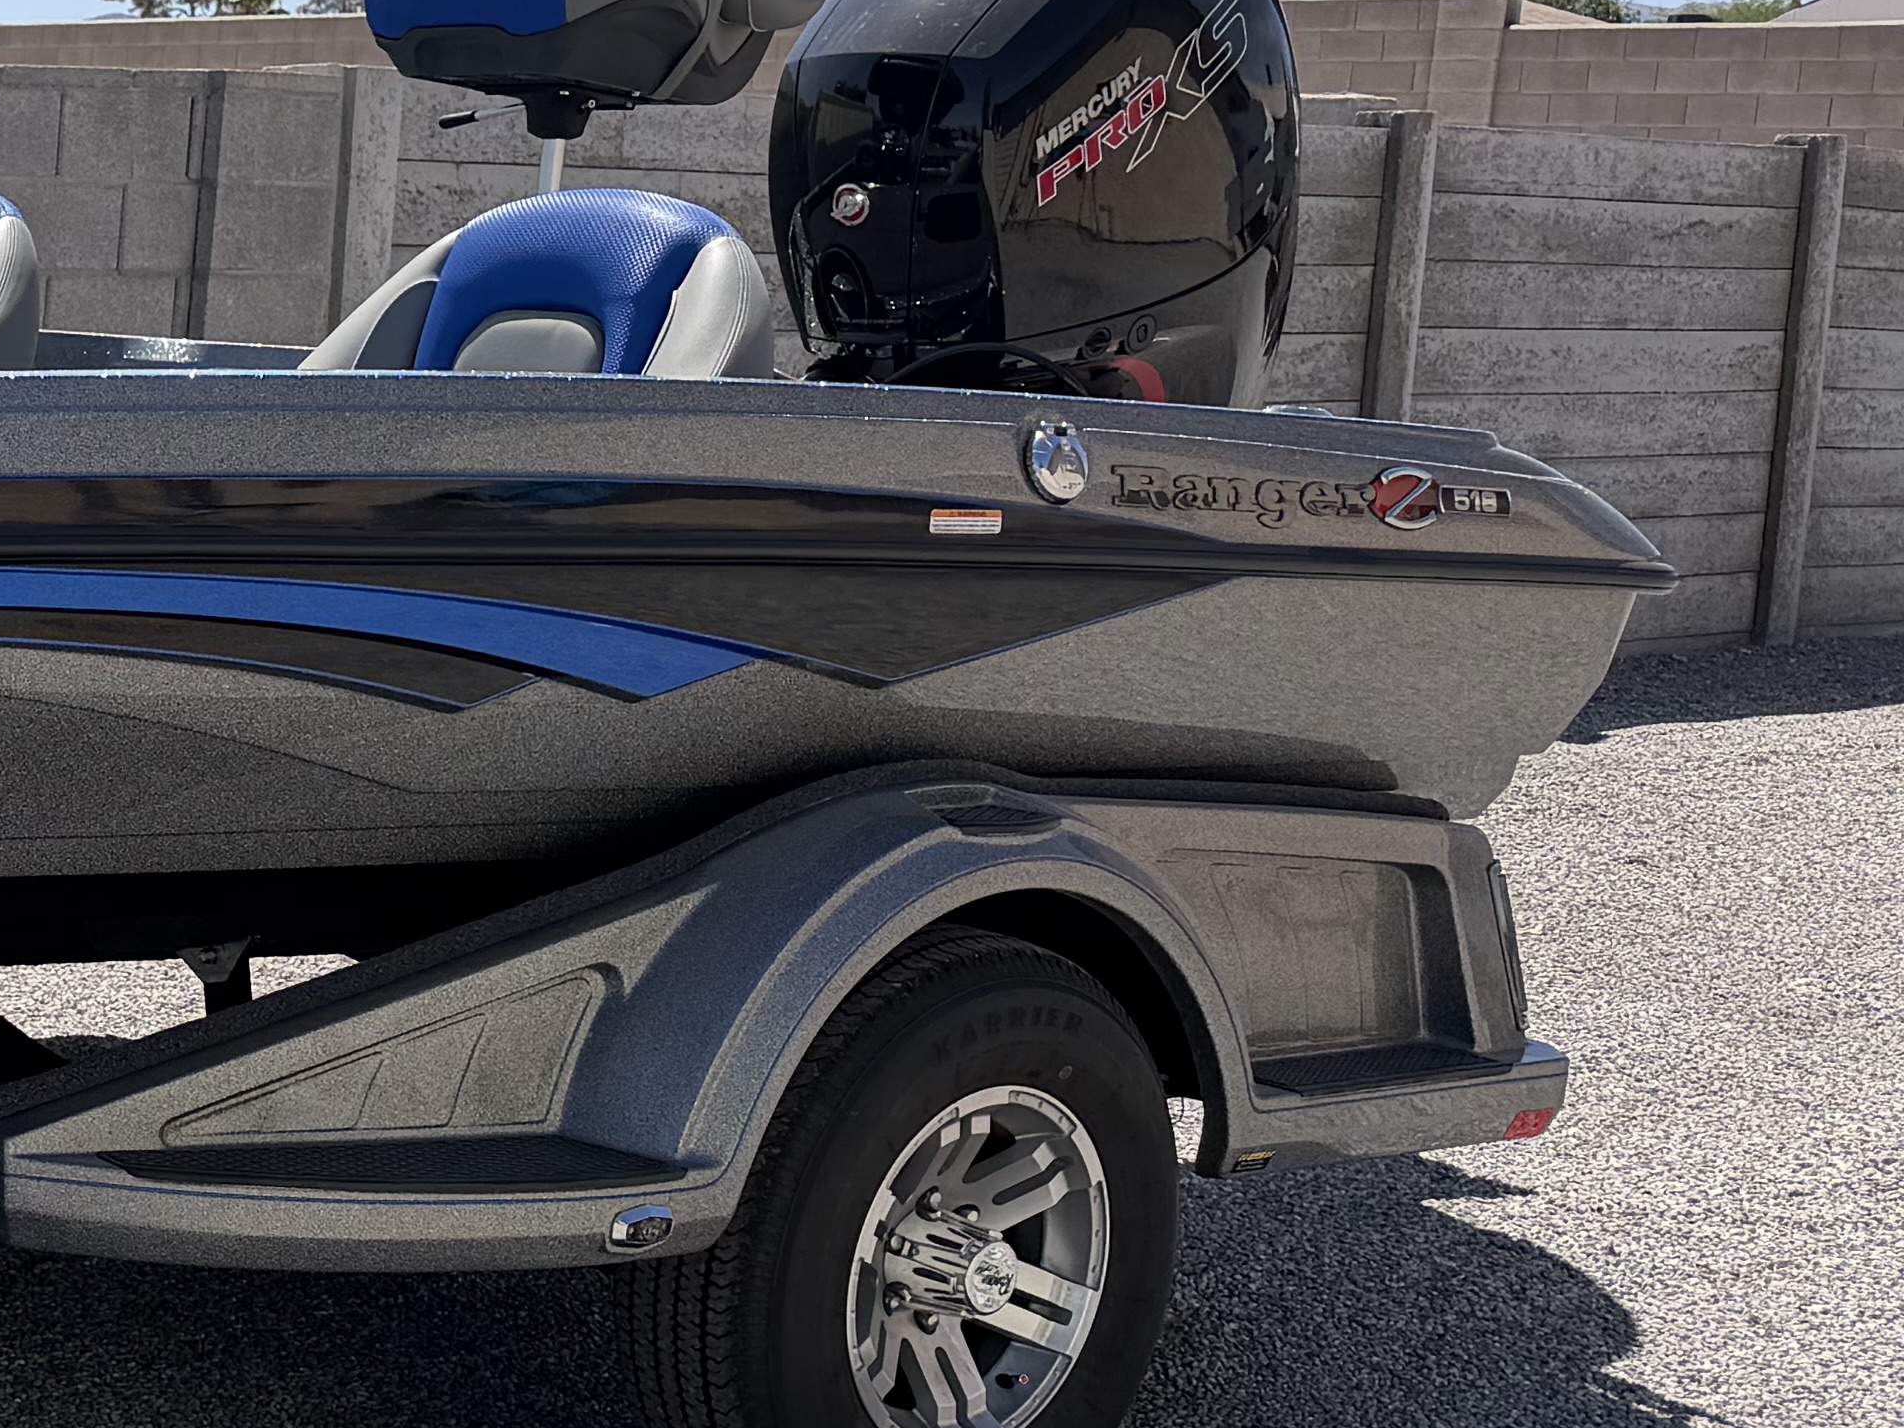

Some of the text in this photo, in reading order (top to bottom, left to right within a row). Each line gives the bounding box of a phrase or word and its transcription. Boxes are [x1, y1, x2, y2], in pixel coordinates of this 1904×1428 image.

[1035, 57, 1143, 160] MERCURY
[1038, 75, 1167, 206] PRO
[1111, 464, 1376, 529] Ranger
[1454, 490, 1498, 513] 518
[930, 1005, 1085, 1066] KARRIER
